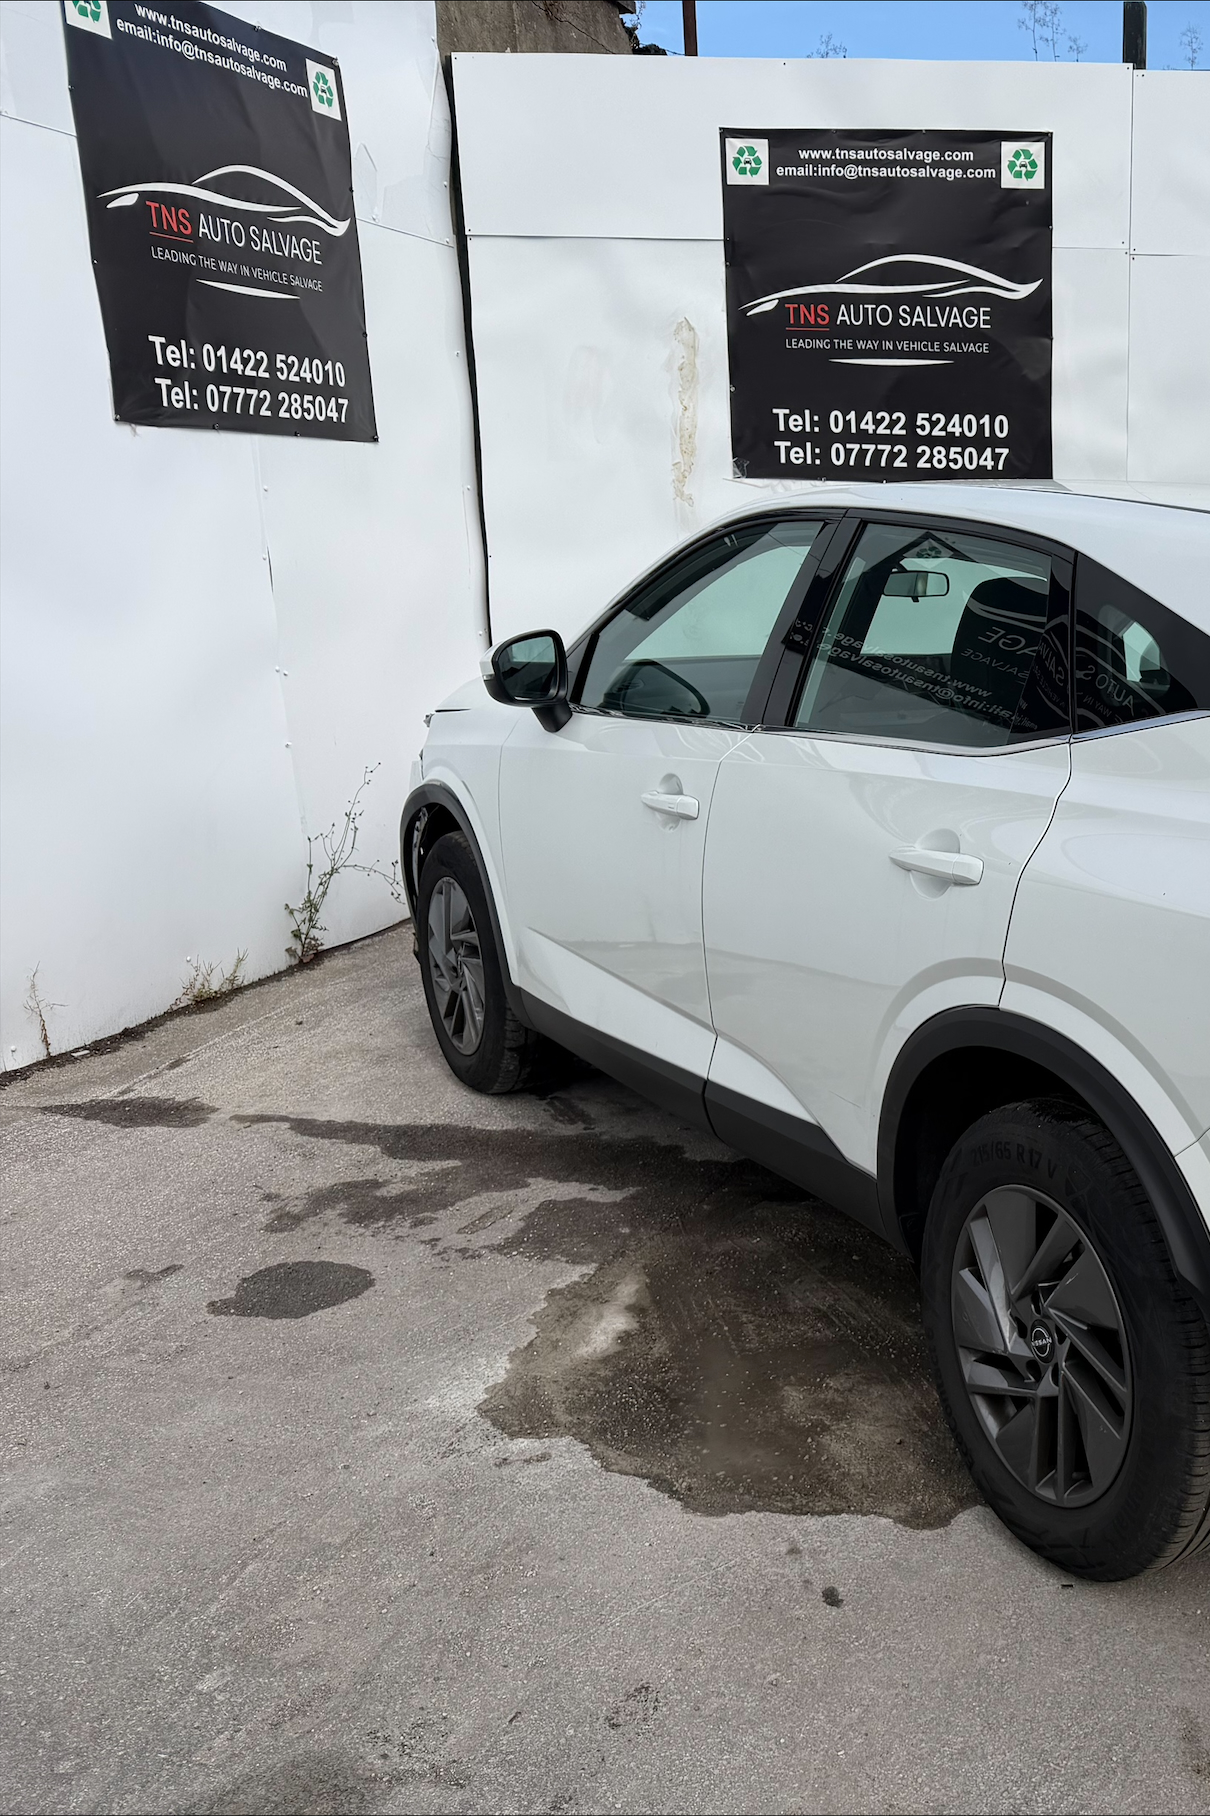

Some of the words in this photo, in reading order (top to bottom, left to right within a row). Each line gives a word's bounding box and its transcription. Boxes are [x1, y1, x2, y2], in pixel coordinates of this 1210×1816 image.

[135, 4, 287, 71] www.tnsautosalvage.com
[116, 18, 308, 98] email:info@tnsautosalvage.com
[799, 149, 973, 163] www.tnsautosalvage.com
[776, 166, 996, 180] email:info@tnsautosalvage.com
[146, 201, 192, 236] TNS
[199, 214, 245, 247] AUTO
[250, 226, 322, 264] SALVAGE
[152, 246, 196, 266] LEADING
[198, 255, 217, 270] THE
[218, 260, 237, 274] WAY
[240, 265, 250, 276] IN
[251, 267, 288, 284] VEHICLE
[290, 275, 322, 292] SALVAGE
[785, 304, 829, 324] TNS
[837, 304, 892, 326] AUTO
[899, 305, 990, 328] SALVAGE
[786, 339, 830, 349] LEADING
[833, 339, 853, 349] THE
[856, 340, 879, 350] WAY
[882, 340, 893, 350] IN
[896, 341, 940, 352] VEHICLE
[944, 342, 989, 353] SALVAGE
[148, 336, 195, 369] Tel:
[203, 344, 270, 378] 01422
[276, 354, 345, 387] 524010
[155, 378, 198, 410] Tel:
[206, 384, 271, 416] 07772
[278, 392, 348, 422] 285047
[772, 409, 819, 432] Tel:
[830, 410, 906, 434] 01422
[916, 413, 1008, 438] 524010
[774, 441, 820, 464] Tel:
[831, 443, 907, 467] 07772
[917, 446, 1009, 470] 285047
[971, 1140, 1012, 1167] 215/65
